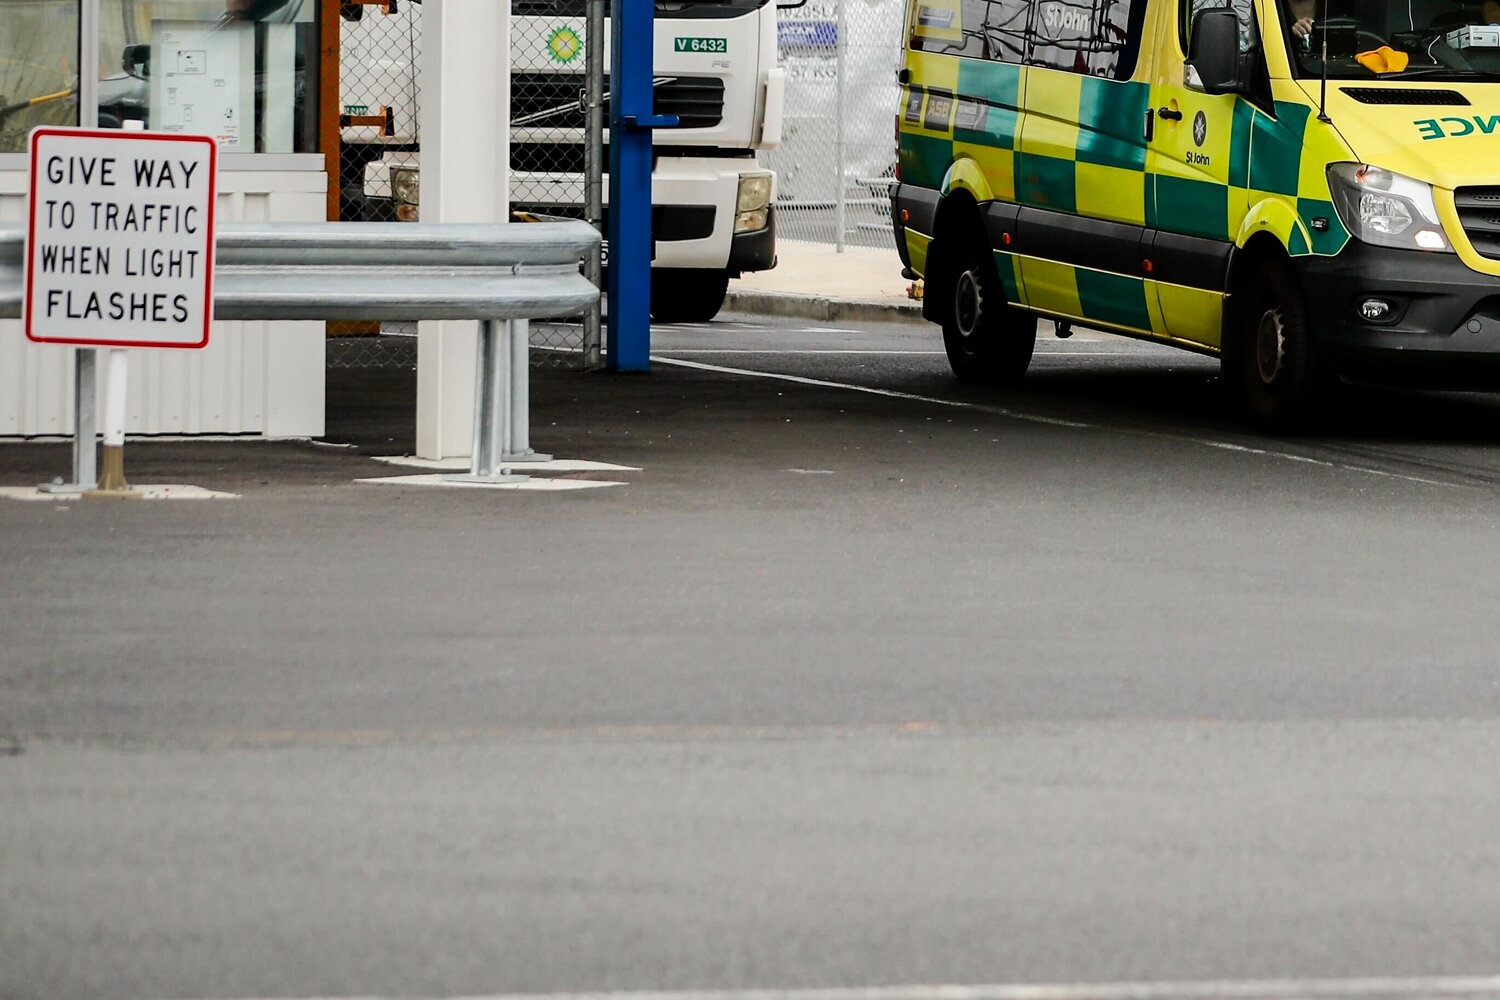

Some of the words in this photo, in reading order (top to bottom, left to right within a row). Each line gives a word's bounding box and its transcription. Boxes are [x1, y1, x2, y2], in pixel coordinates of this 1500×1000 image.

[1057, 6, 1089, 32] John
[676, 38, 687, 50] V
[691, 38, 725, 51] 6432
[927, 100, 950, 117] ASB
[47, 156, 116, 186] GIVE
[134, 159, 198, 189] WAY
[1186, 151, 1193, 164] St
[1193, 152, 1210, 166] John
[46, 200, 75, 229] TO
[91, 202, 198, 234] TRAFFIC
[41, 245, 110, 275] WHEN
[126, 248, 199, 279] LIGHT
[47, 290, 189, 323] FLASHES
